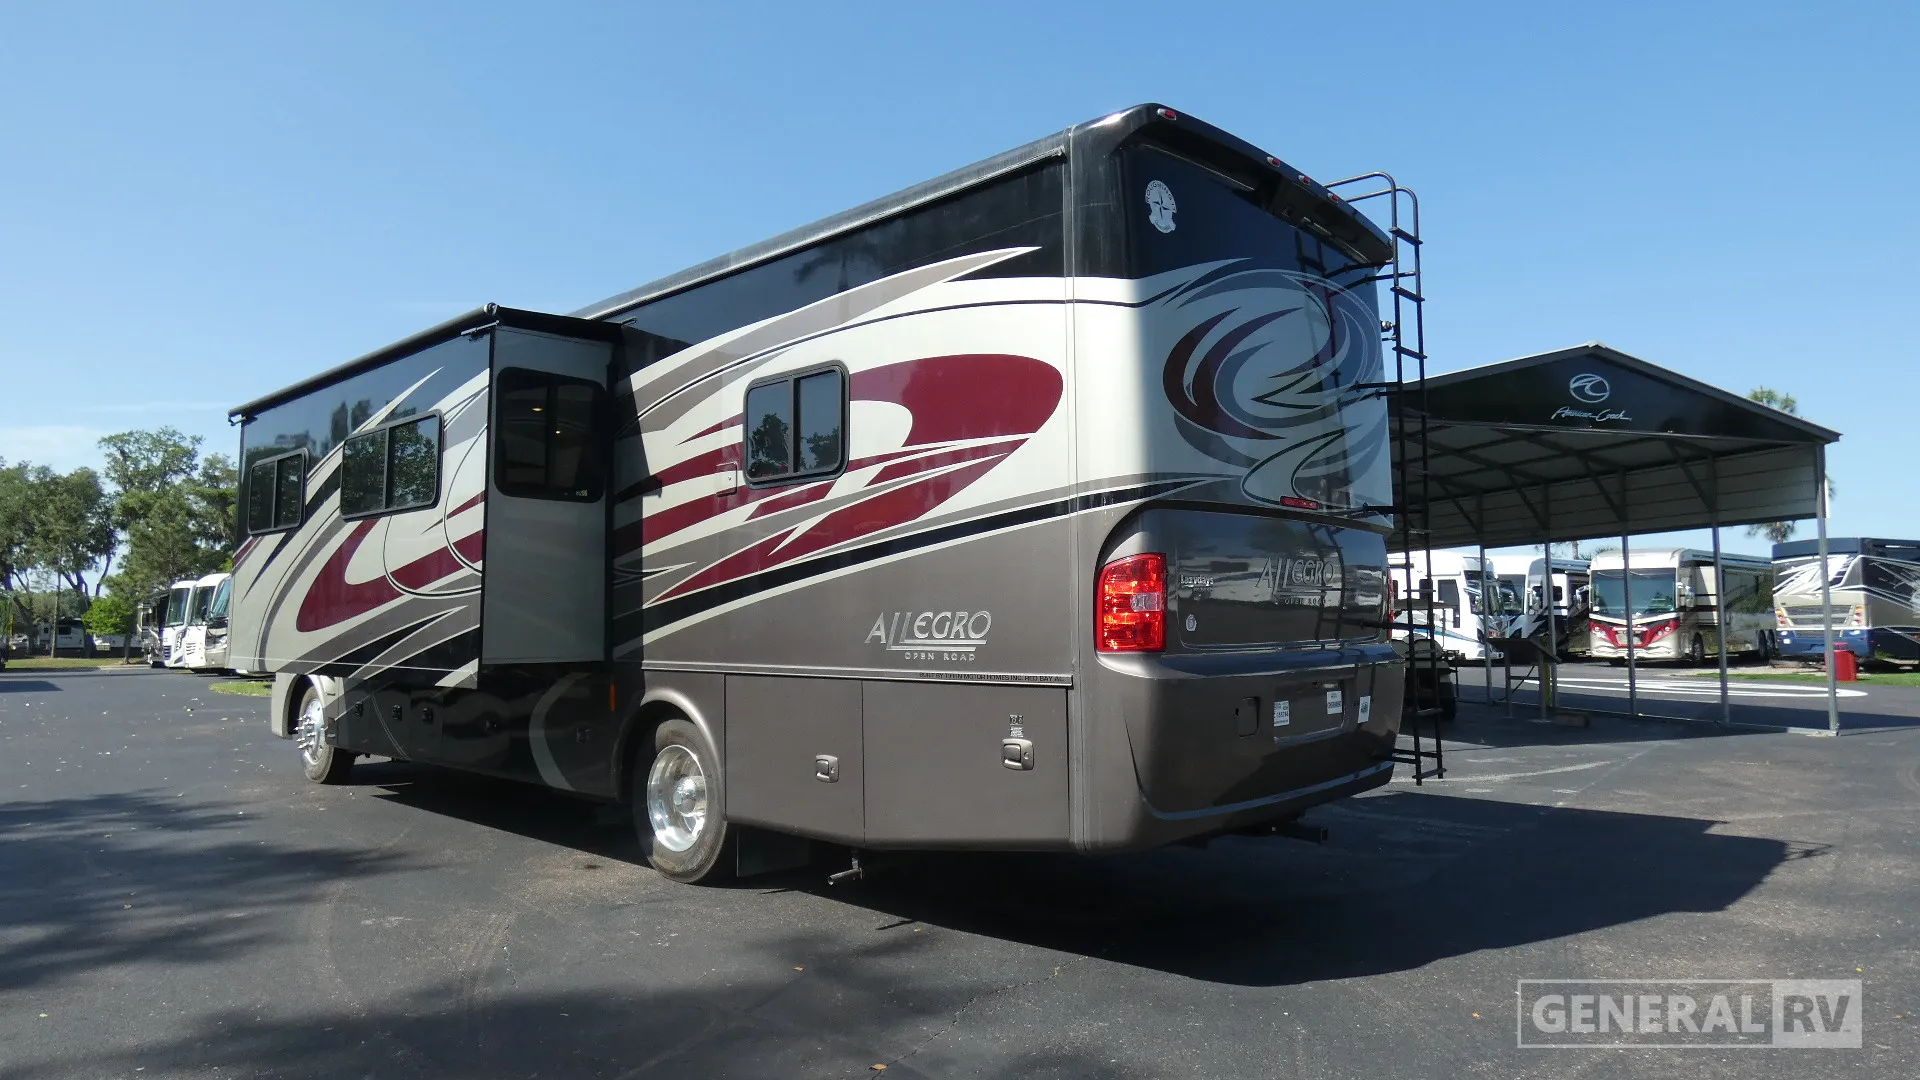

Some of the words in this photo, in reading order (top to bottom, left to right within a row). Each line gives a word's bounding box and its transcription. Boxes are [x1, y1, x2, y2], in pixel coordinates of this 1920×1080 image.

[1551, 406, 1596, 420] American
[1595, 409, 1632, 422] Coach
[1255, 557, 1335, 596] ALLEGRO
[864, 611, 992, 651] ALLEGRO
[904, 652, 935, 661] OPEN
[943, 653, 976, 662] ROAD
